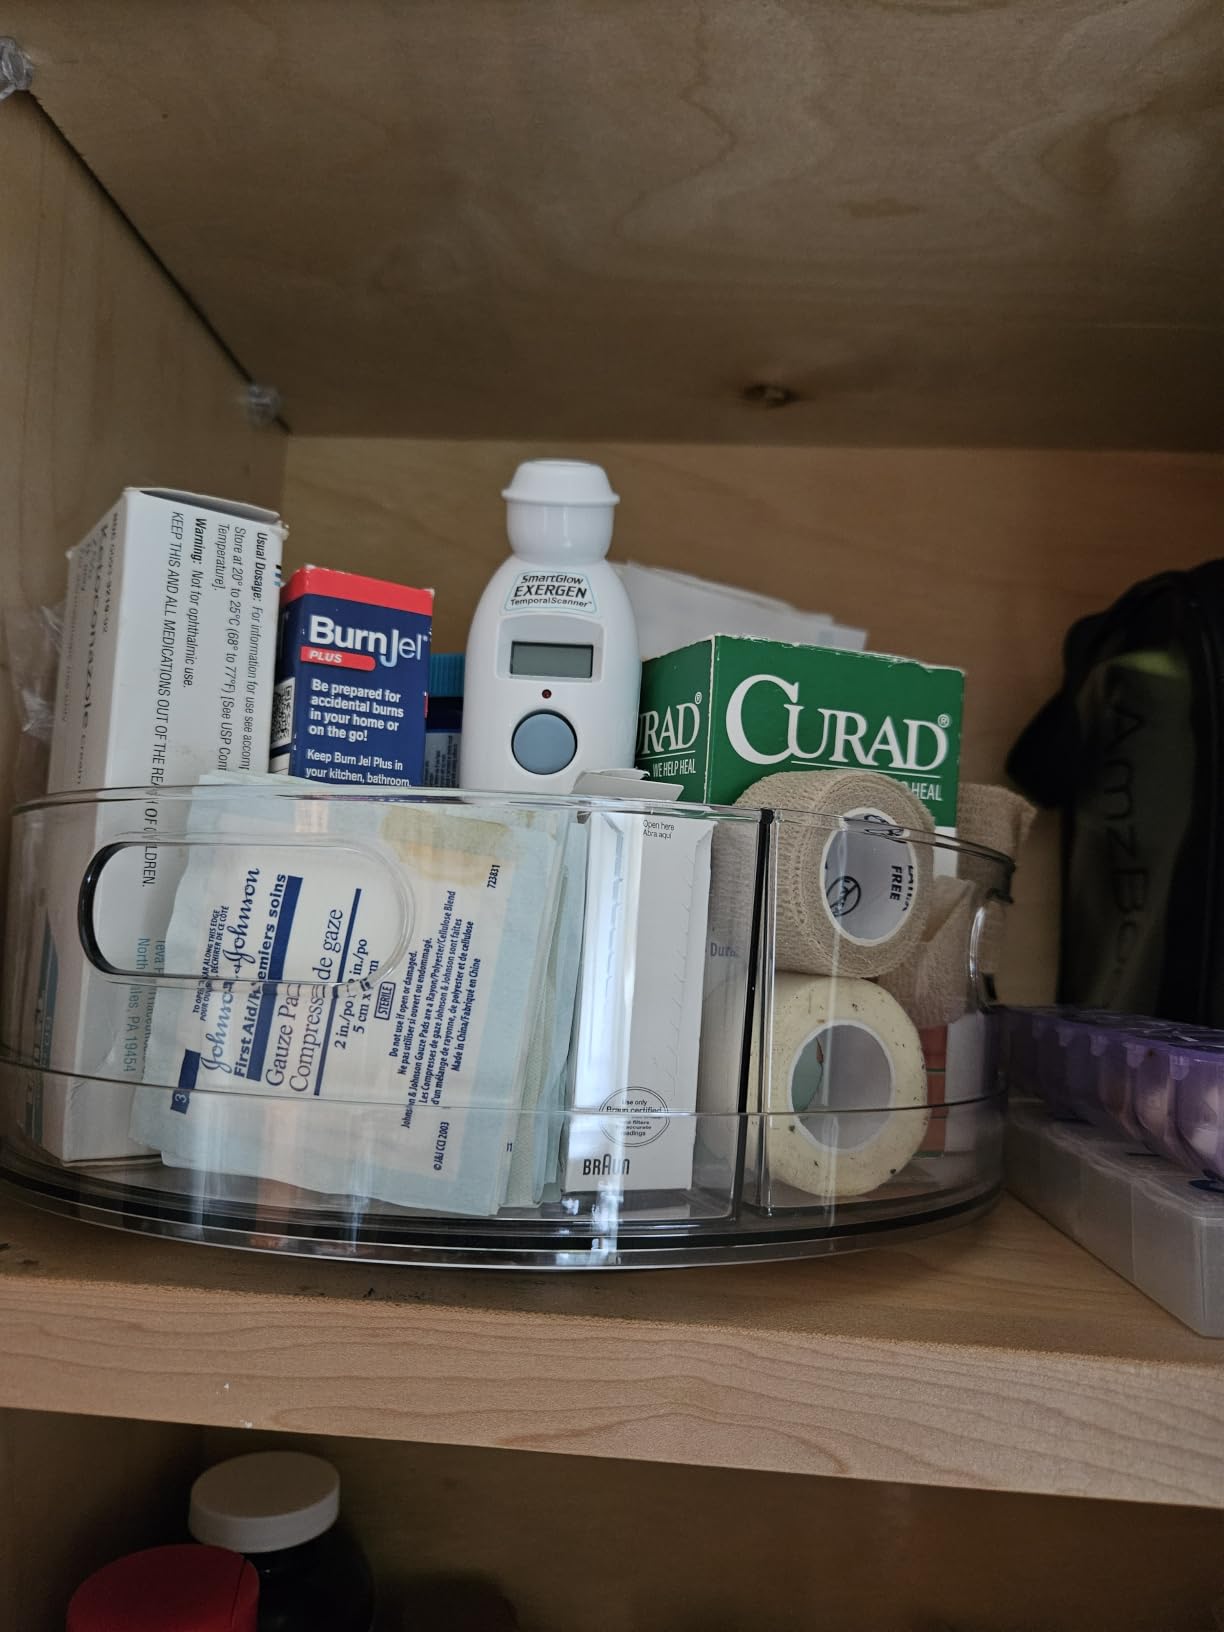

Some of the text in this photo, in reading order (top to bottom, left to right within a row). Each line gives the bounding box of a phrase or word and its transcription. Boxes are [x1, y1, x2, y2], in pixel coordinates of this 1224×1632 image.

[233, 526, 246, 554] Store
[212, 523, 229, 591] Temperature].
[232, 555, 243, 567] at
[231, 567, 244, 587] 20°
[521, 574, 584, 585] SmartGlow
[230, 588, 243, 598] to
[513, 584, 587, 599] EXERGEN
[183, 518, 207, 688] Warning: Not for ophthalmic use.
[228, 600, 241, 626] 25°C
[226, 628, 239, 651] (68°
[243, 532, 268, 733] Usual Dosage: For information for use see
[225, 652, 237, 663] to
[308, 650, 343, 664] PLUS
[144, 511, 184, 825] KEEP THIS AND ALL MEDICATIONS OUT OF THE OF
[221, 665, 237, 694] 77°F)
[311, 678, 401, 703] Be prepared for
[310, 695, 404, 717] accidental burns
[309, 708, 400, 731] in your home or
[220, 721, 233, 745] USP
[308, 725, 368, 742] on the go!
[307, 750, 404, 770] Keep Burn Jel Plus in
[653, 758, 697, 777] WE HELP HEAL
[306, 767, 412, 787] your kitchen, bathroom,
[912, 783, 943, 801] HEAL
[643, 819, 675, 831] Open here
[643, 828, 672, 840] Abra aquí
[487, 864, 500, 889] 723831
[889, 865, 903, 901] FREE
[443, 890, 455, 911] Blend
[211, 909, 220, 927] EDGE
[220, 905, 229, 922] CÔTÉ
[222, 868, 260, 964] Johnson
[208, 928, 217, 943] THIS
[216, 932, 223, 941] DE
[218, 923, 225, 931] CE
[449, 918, 462, 938] faites
[460, 920, 474, 951] cellulose
[136, 938, 150, 970] North
[312, 909, 343, 980] de gaze
[448, 939, 458, 955] sont
[203, 944, 214, 966] ALONG
[210, 942, 221, 975] DÉCHIRER
[352, 939, 368, 976] in./po
[416, 937, 433, 983] endommagé.
[457, 952, 467, 961] de
[402, 950, 417, 985] damaged.
[440, 955, 455, 985] Johnson
[457, 961, 465, 970] et
[468, 957, 481, 977] Chine
[234, 874, 286, 1078] First soins
[468, 978, 477, 988] en
[402, 985, 410, 994] or
[415, 983, 423, 993] ou
[450, 970, 464, 1004] polyester
[364, 993, 372, 1001] x
[378, 986, 393, 1015] STERILE
[399, 994, 409, 1013] open
[410, 993, 421, 1017] ouvert
[434, 991, 447, 1021] Johnson
[192, 1003, 200, 1014] TO
[200, 1002, 209, 1021] POUR
[358, 1004, 369, 1022] cm
[423, 1008, 432, 1020] are
[447, 1004, 457, 1014] de
[127, 1016, 140, 1032] PA
[339, 1000, 354, 1039] in./po
[395, 1020, 404, 1032] use
[418, 1020, 430, 1038] Pads
[352, 1024, 365, 1035] 5
[402, 1024, 415, 1050] utiliser
[432, 1021, 442, 1039] gaze
[443, 1015, 456, 1046] rayonne,
[334, 1039, 346, 1049] 2
[392, 1033, 401, 1046] not
[414, 1038, 426, 1060] Gauze
[428, 1039, 438, 1048] de
[453, 1042, 464, 1050] in
[123, 1037, 138, 1073] 19454
[265, 1024, 293, 1086] Gauze
[388, 1047, 398, 1057] Do
[401, 1051, 410, 1064] pas
[439, 1046, 449, 1056] de
[396, 1064, 407, 1075] Ne
[420, 1049, 436, 1090] Compresses
[450, 1051, 463, 1071] Made
[408, 1061, 422, 1091] Johnson
[175, 1093, 187, 1104] 3
[417, 1091, 428, 1103] Les
[438, 1121, 450, 1140] 2003
[583, 1153, 630, 1176] BRAUN
